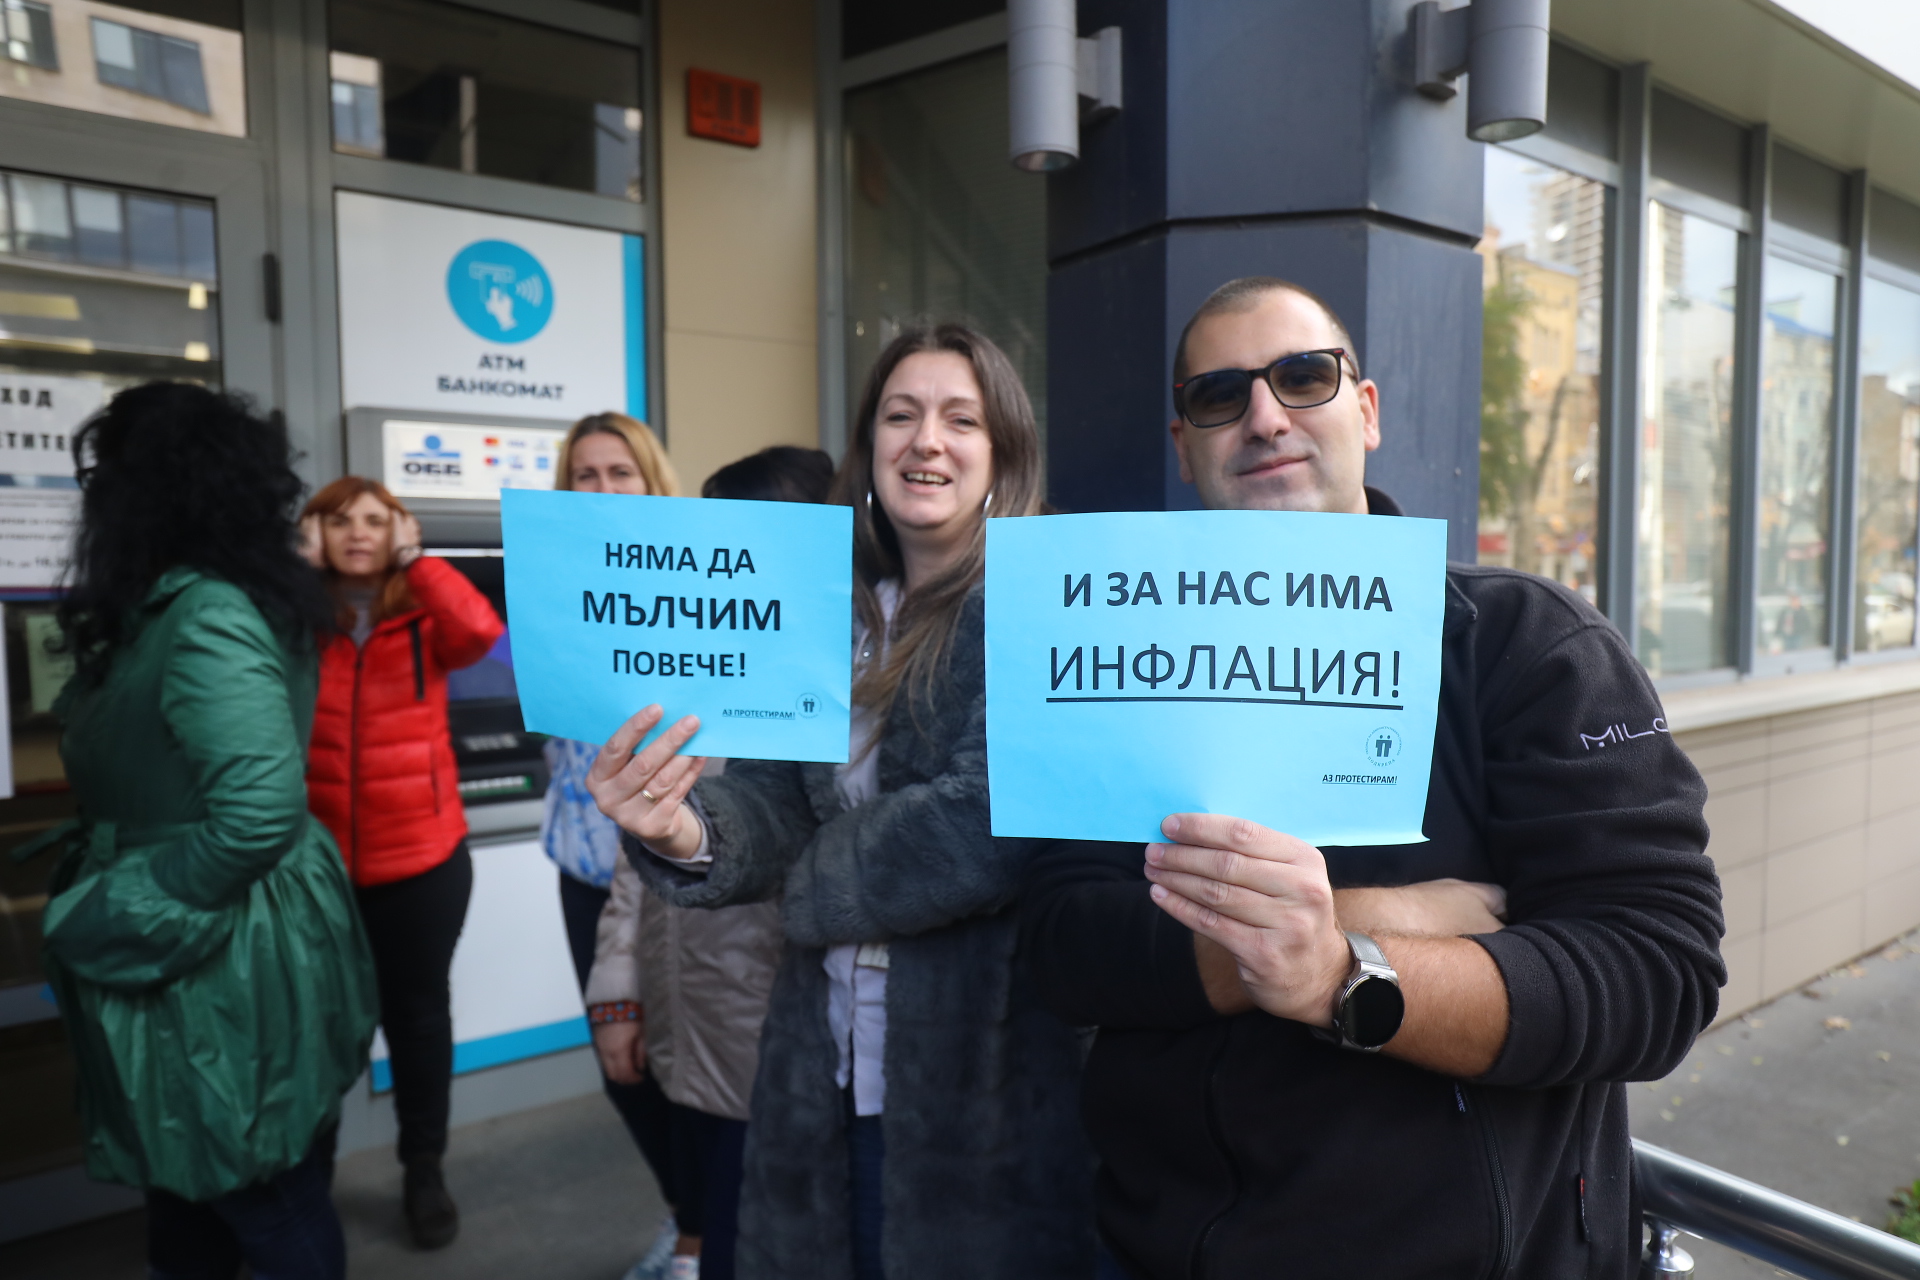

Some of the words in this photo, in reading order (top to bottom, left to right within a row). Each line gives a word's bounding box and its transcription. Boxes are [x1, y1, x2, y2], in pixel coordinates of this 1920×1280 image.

[437, 376, 564, 399] БАНКОМАТ
[604, 542, 698, 572] НЯМА
[707, 548, 756, 579] ДА
[1063, 573, 1092, 607] И
[1106, 571, 1162, 607] ЗА
[1177, 570, 1270, 606] НАС
[1285, 572, 1393, 612] ИМА
[582, 590, 781, 631] МЪЛЧИМ
[612, 649, 746, 677] ПОВЕЧЕ!
[1050, 643, 1400, 701] ИНФЛАЦИЯ!
[722, 708, 732, 716] АЗ
[734, 709, 795, 719] ПРОТЕСТИРАМ!
[1322, 774, 1333, 783] АЗ
[1334, 774, 1398, 784] ПРОТЕСТИРАМ!
